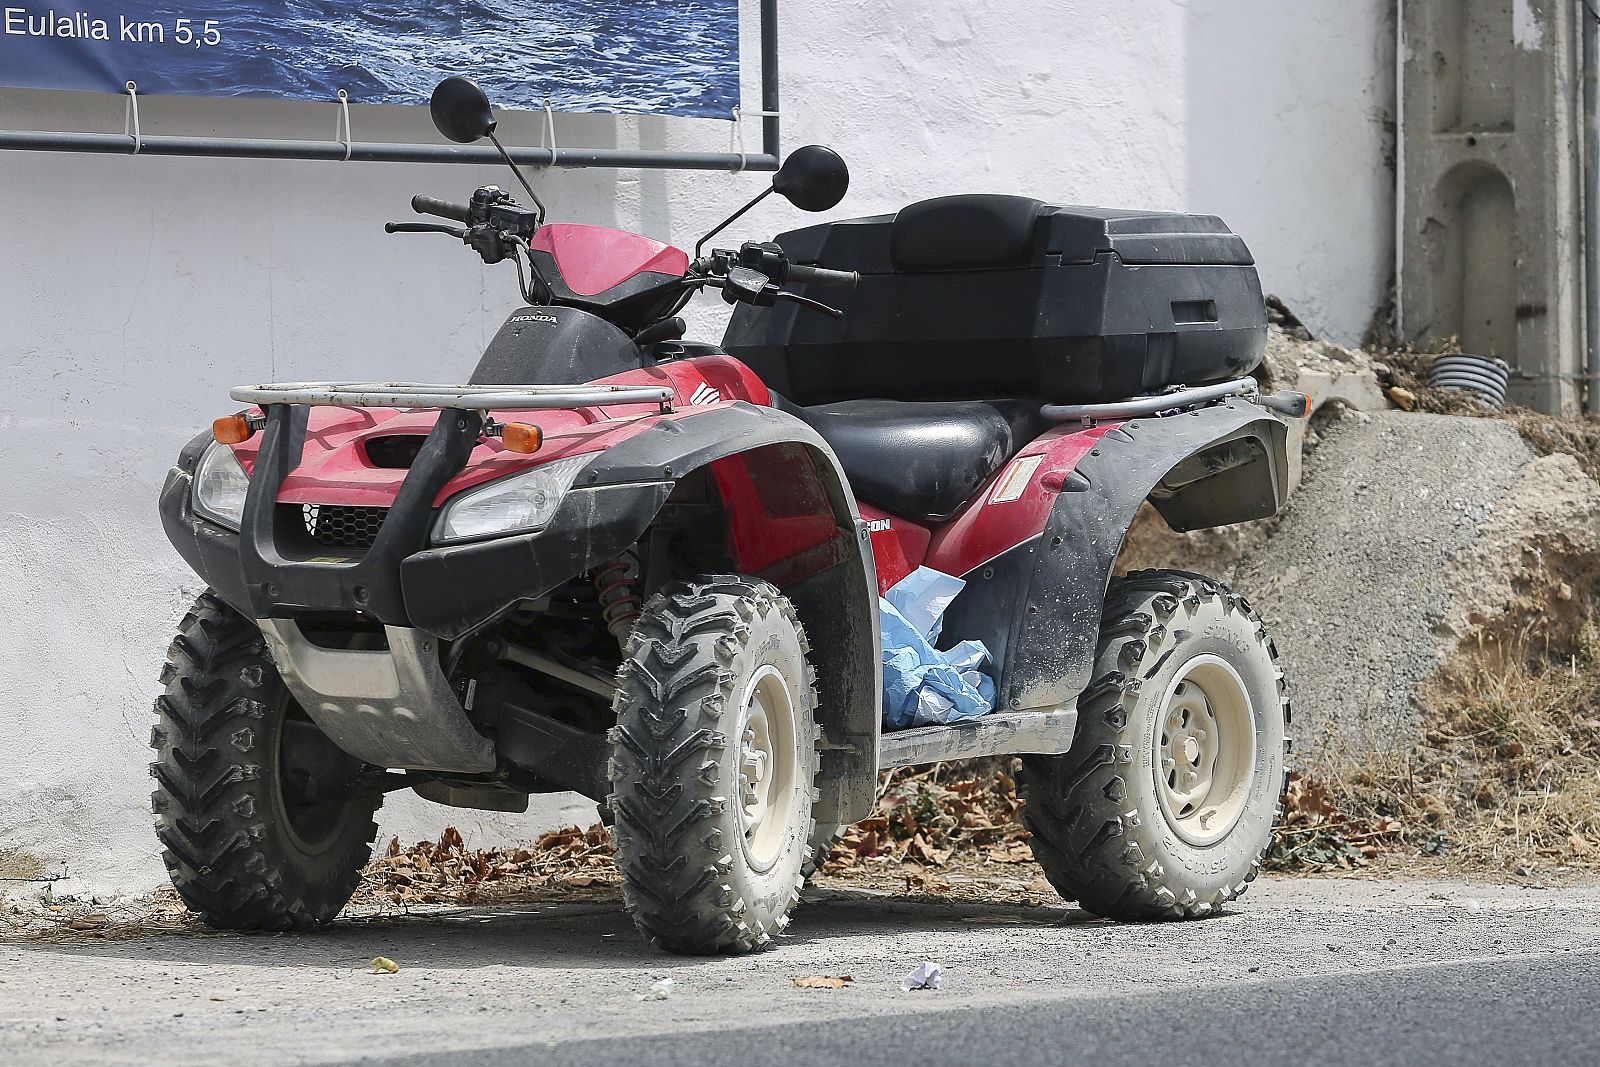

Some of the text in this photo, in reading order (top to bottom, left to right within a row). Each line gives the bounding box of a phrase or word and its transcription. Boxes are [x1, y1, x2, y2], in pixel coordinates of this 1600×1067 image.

[4, 7, 222, 50] Eulalia km 5,5
[510, 315, 558, 324] HONDA
